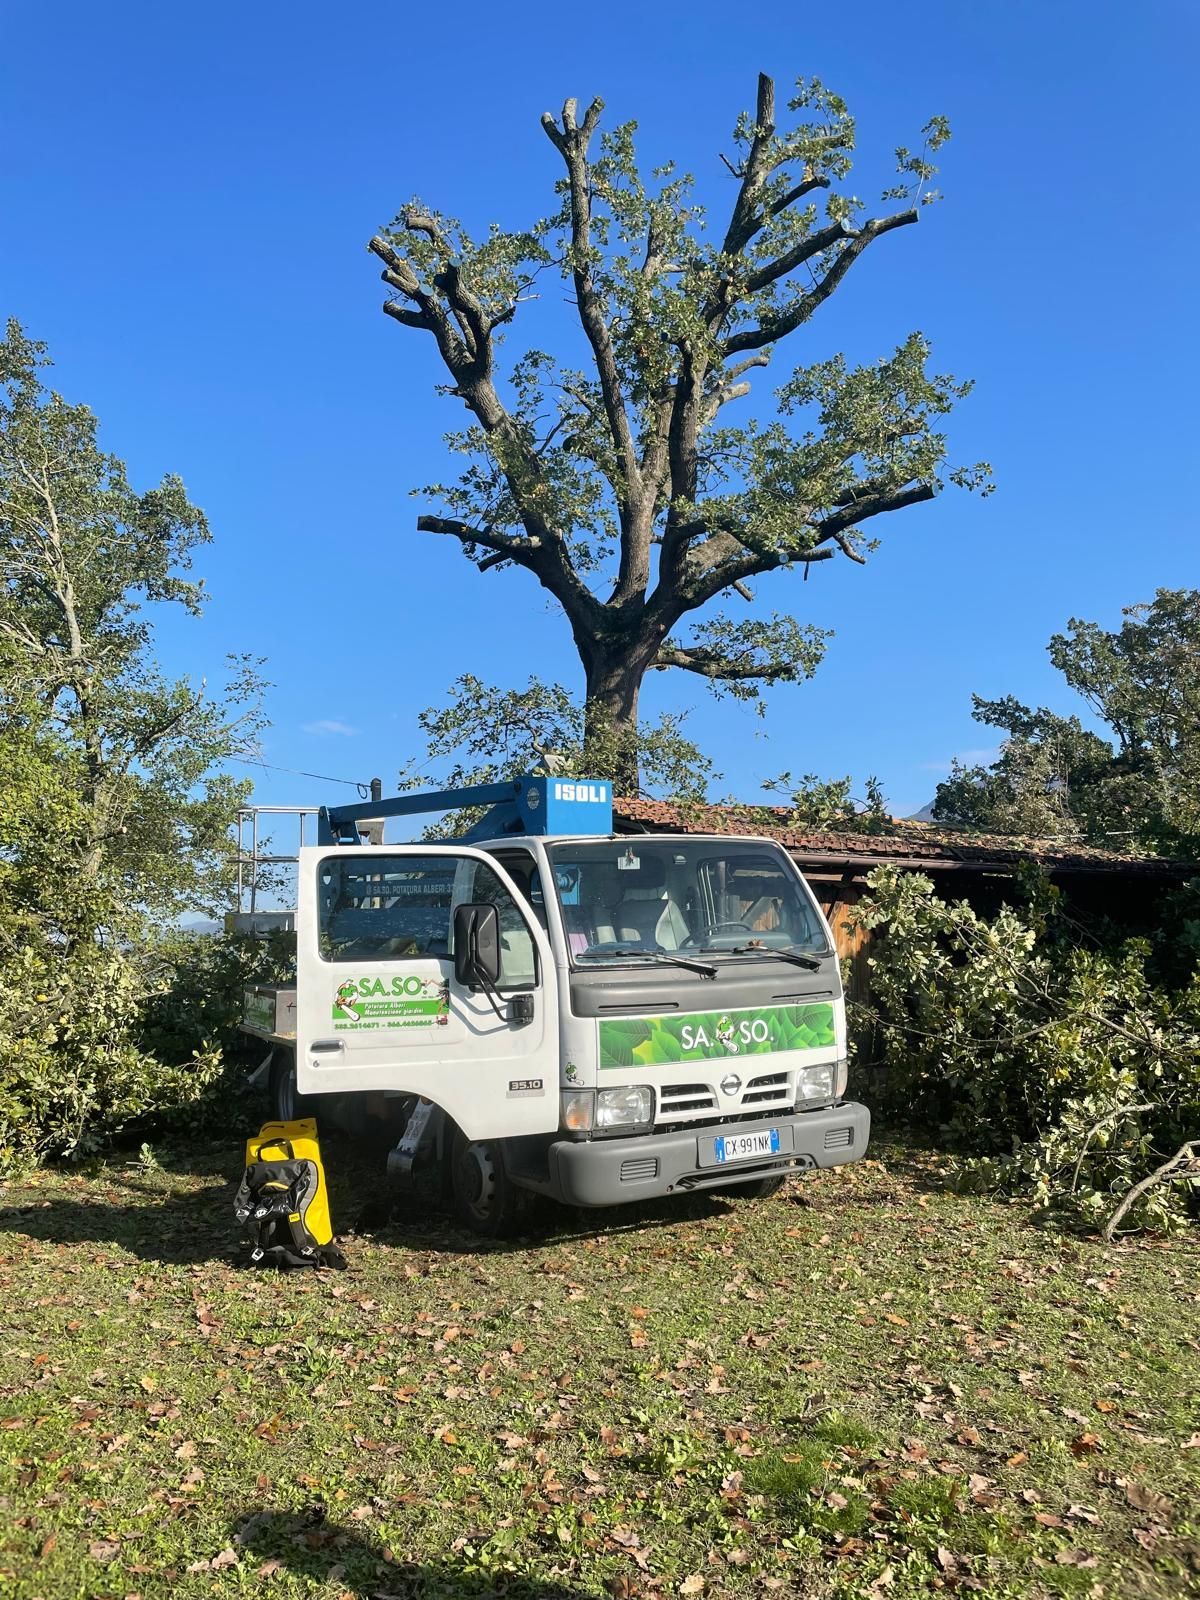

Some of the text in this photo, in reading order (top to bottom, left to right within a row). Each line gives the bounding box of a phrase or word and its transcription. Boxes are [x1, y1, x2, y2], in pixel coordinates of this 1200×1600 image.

[554, 783, 607, 803] ISOLI
[393, 884, 421, 895] POTATURA
[358, 975, 428, 998] SA.SO.
[681, 1019, 775, 1051] SA. SO.
[511, 1080, 541, 1090] 35.10
[724, 1135, 771, 1156] CX 991NK
